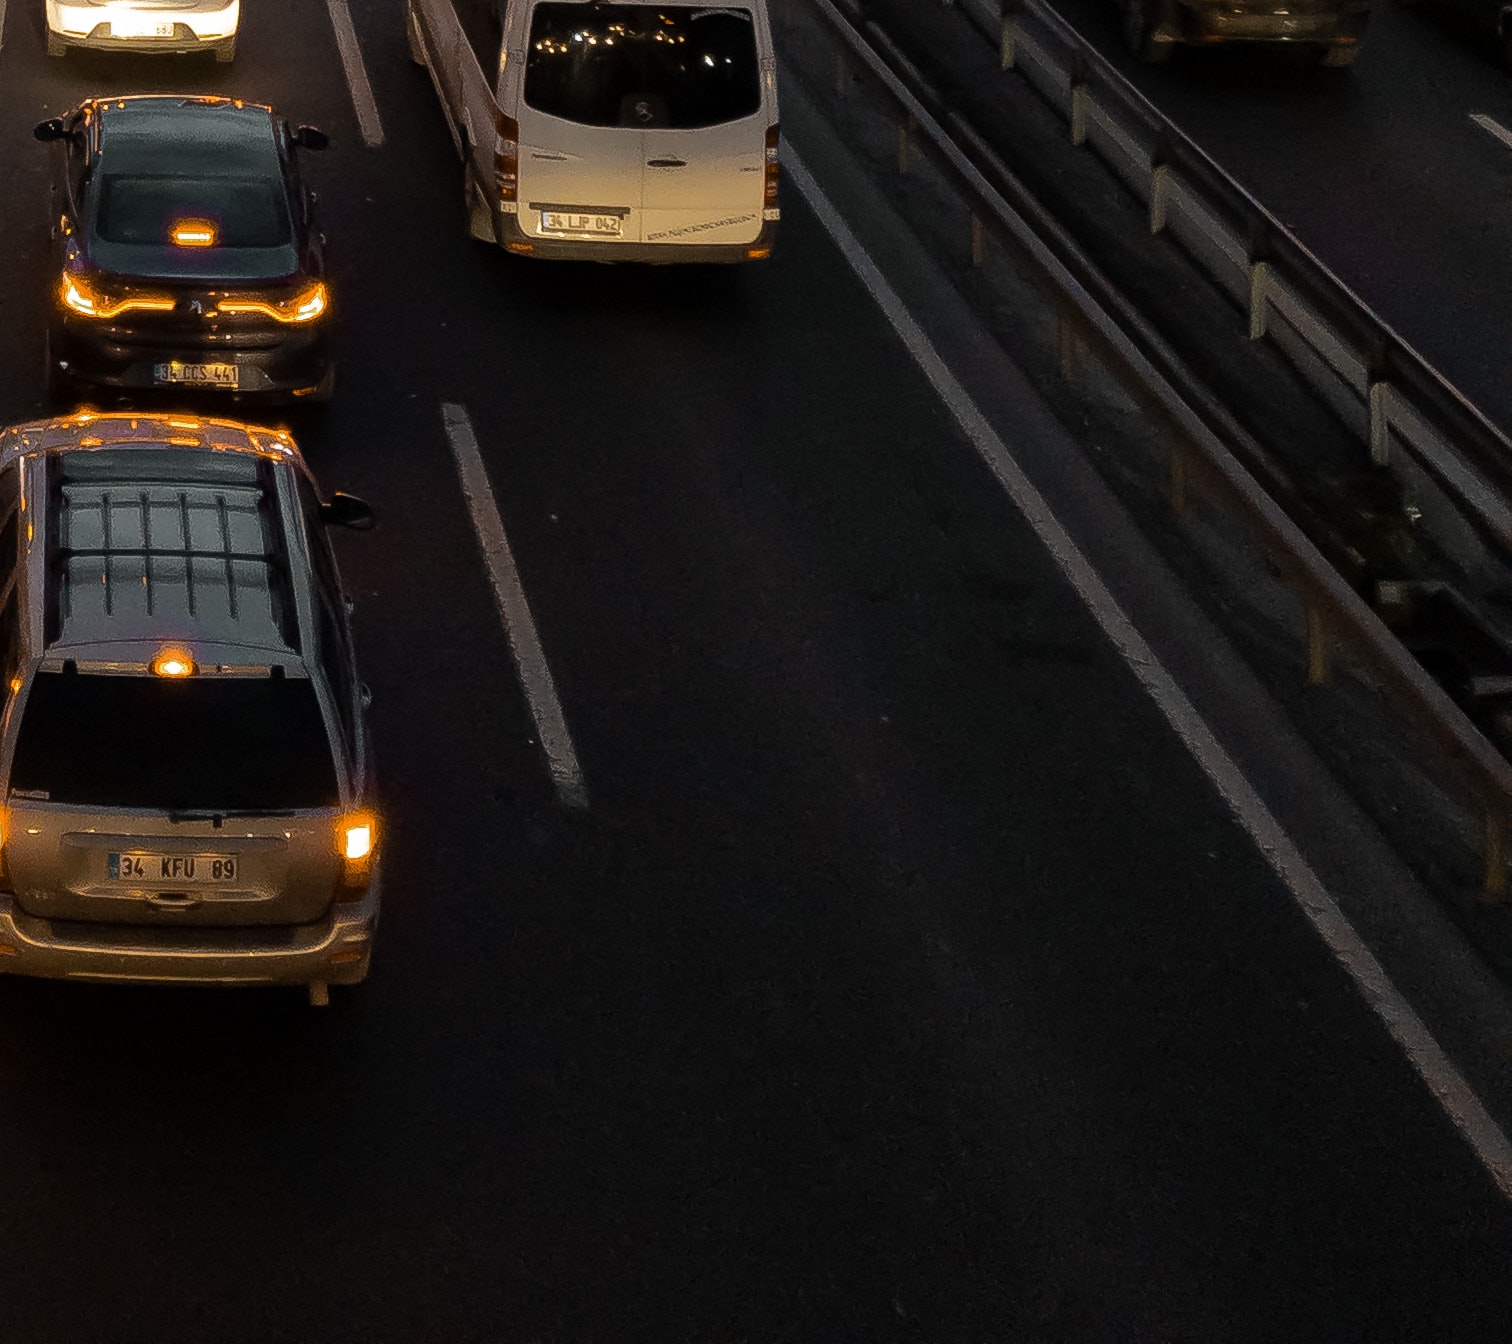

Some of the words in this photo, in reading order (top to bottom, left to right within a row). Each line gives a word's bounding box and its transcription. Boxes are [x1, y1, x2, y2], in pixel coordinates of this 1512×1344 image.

[568, 216, 589, 230] LJP
[595, 217, 618, 231] 042
[161, 365, 177, 380] 34
[213, 366, 238, 382] 441
[121, 857, 145, 878] 34
[161, 857, 196, 879] KFU
